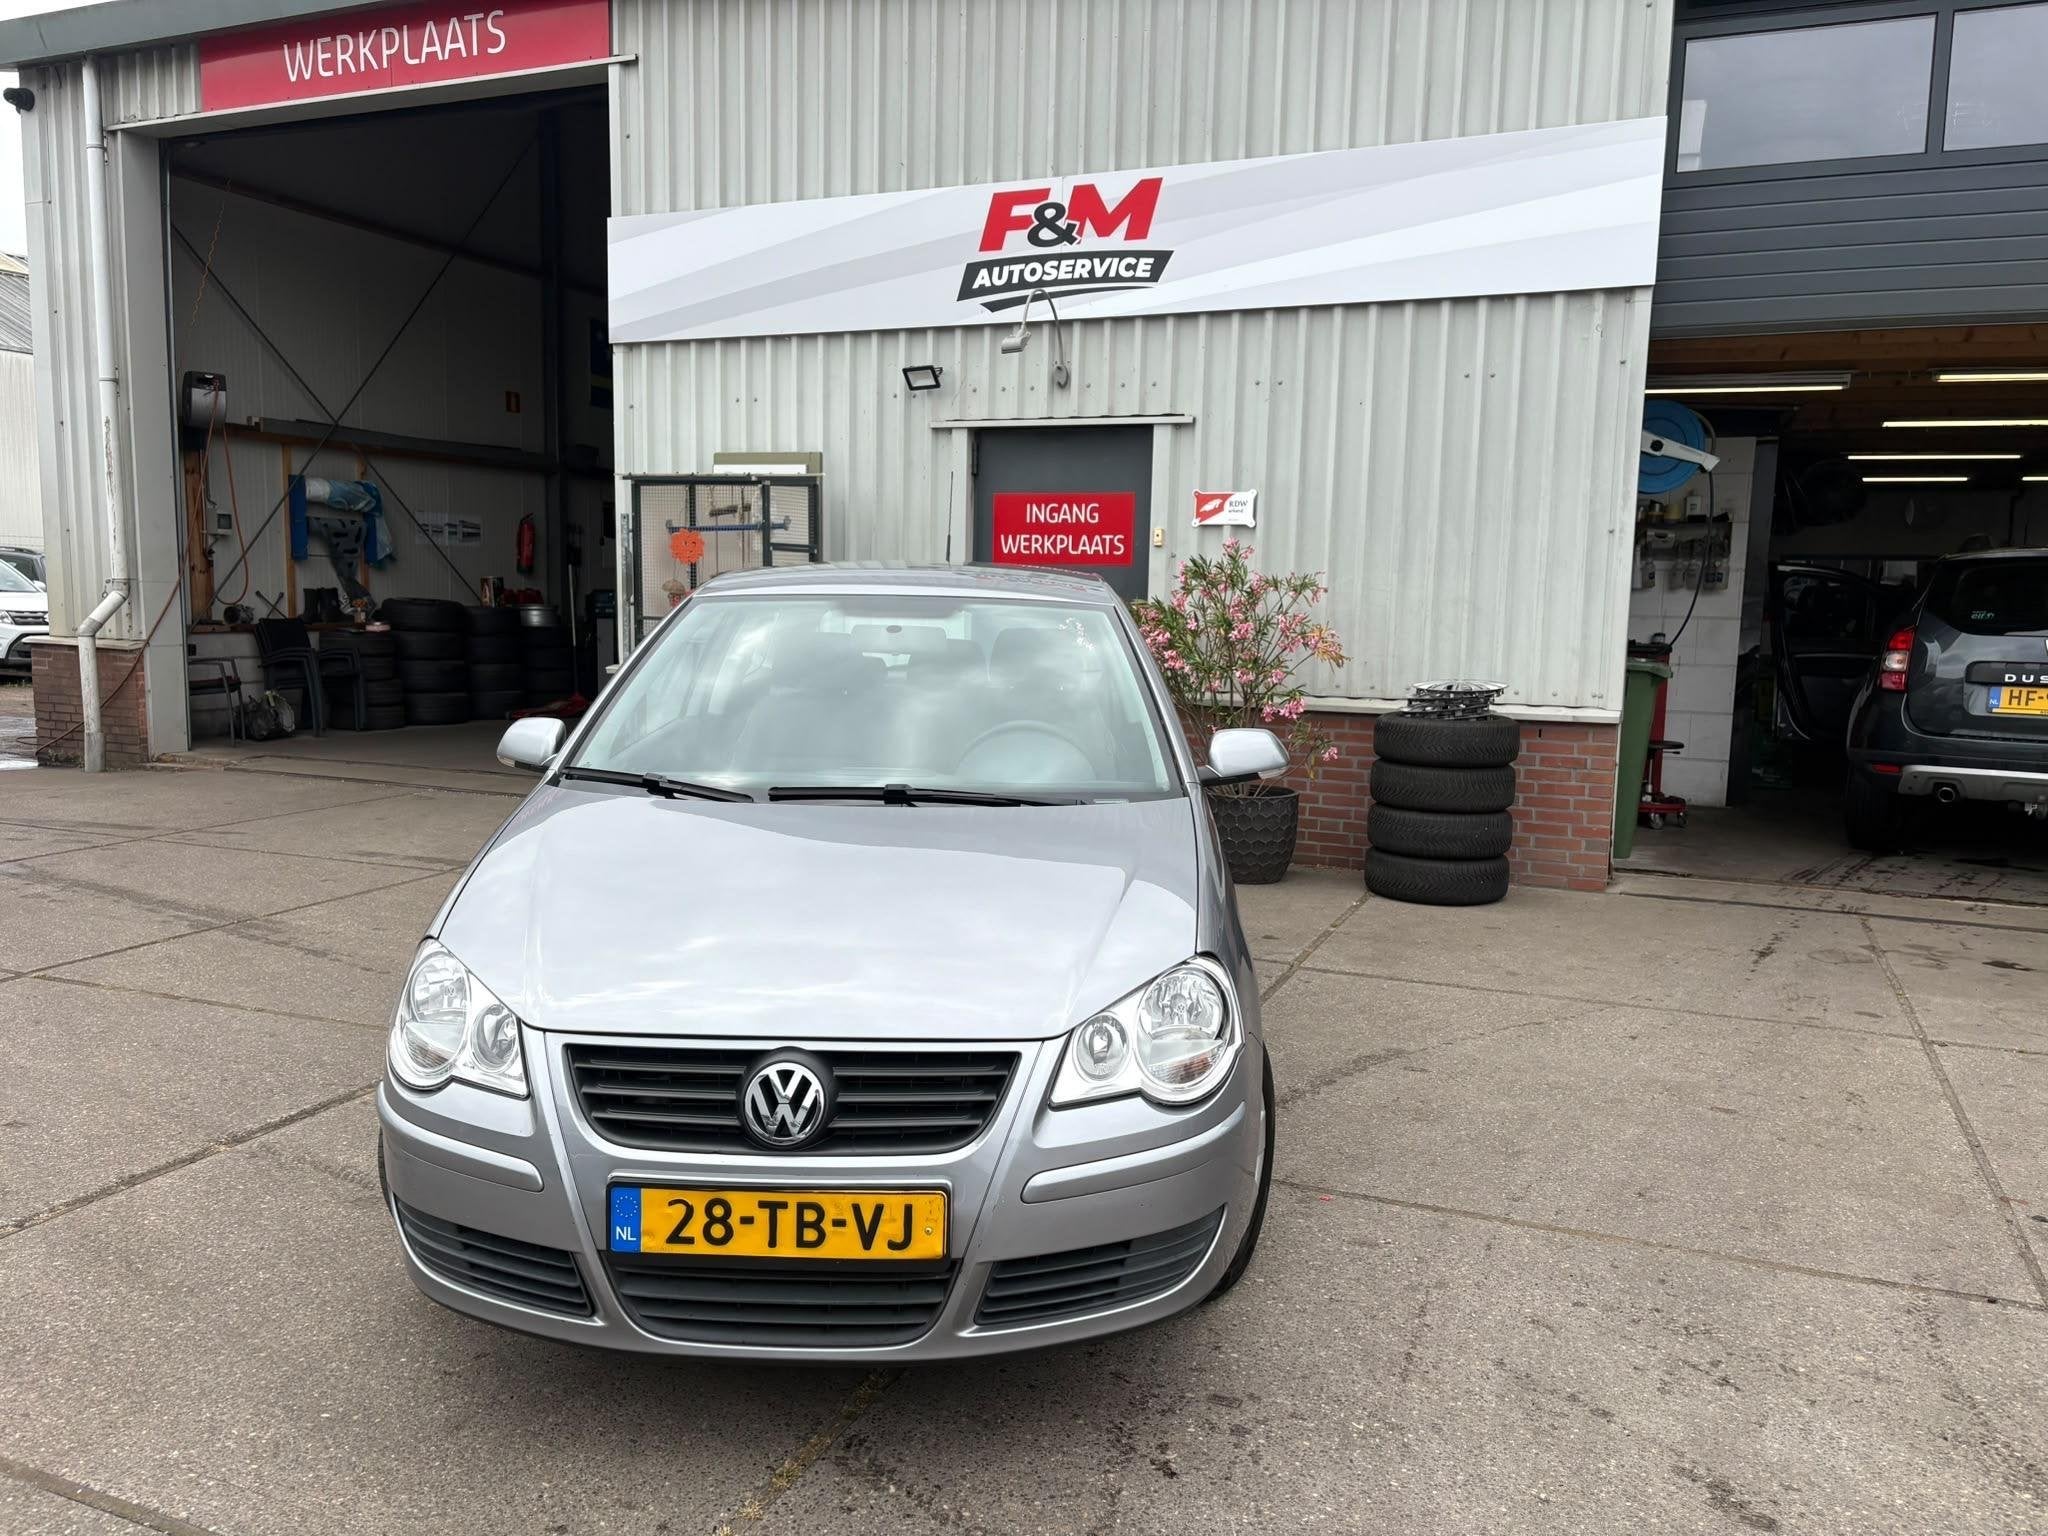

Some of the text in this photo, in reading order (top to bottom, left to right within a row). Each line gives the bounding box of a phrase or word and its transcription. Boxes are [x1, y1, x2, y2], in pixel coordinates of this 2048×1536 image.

[284, 10, 506, 82] WERKPLAATS
[979, 177, 1164, 252] F&M
[972, 257, 1155, 289] AUTOSERVICE
[1025, 503, 1100, 524] INGANG
[1000, 534, 1125, 555] WERKPLAATS
[2008, 689, 2048, 706] HF-
[615, 1198, 913, 1251] NL 28-TB-VJ
